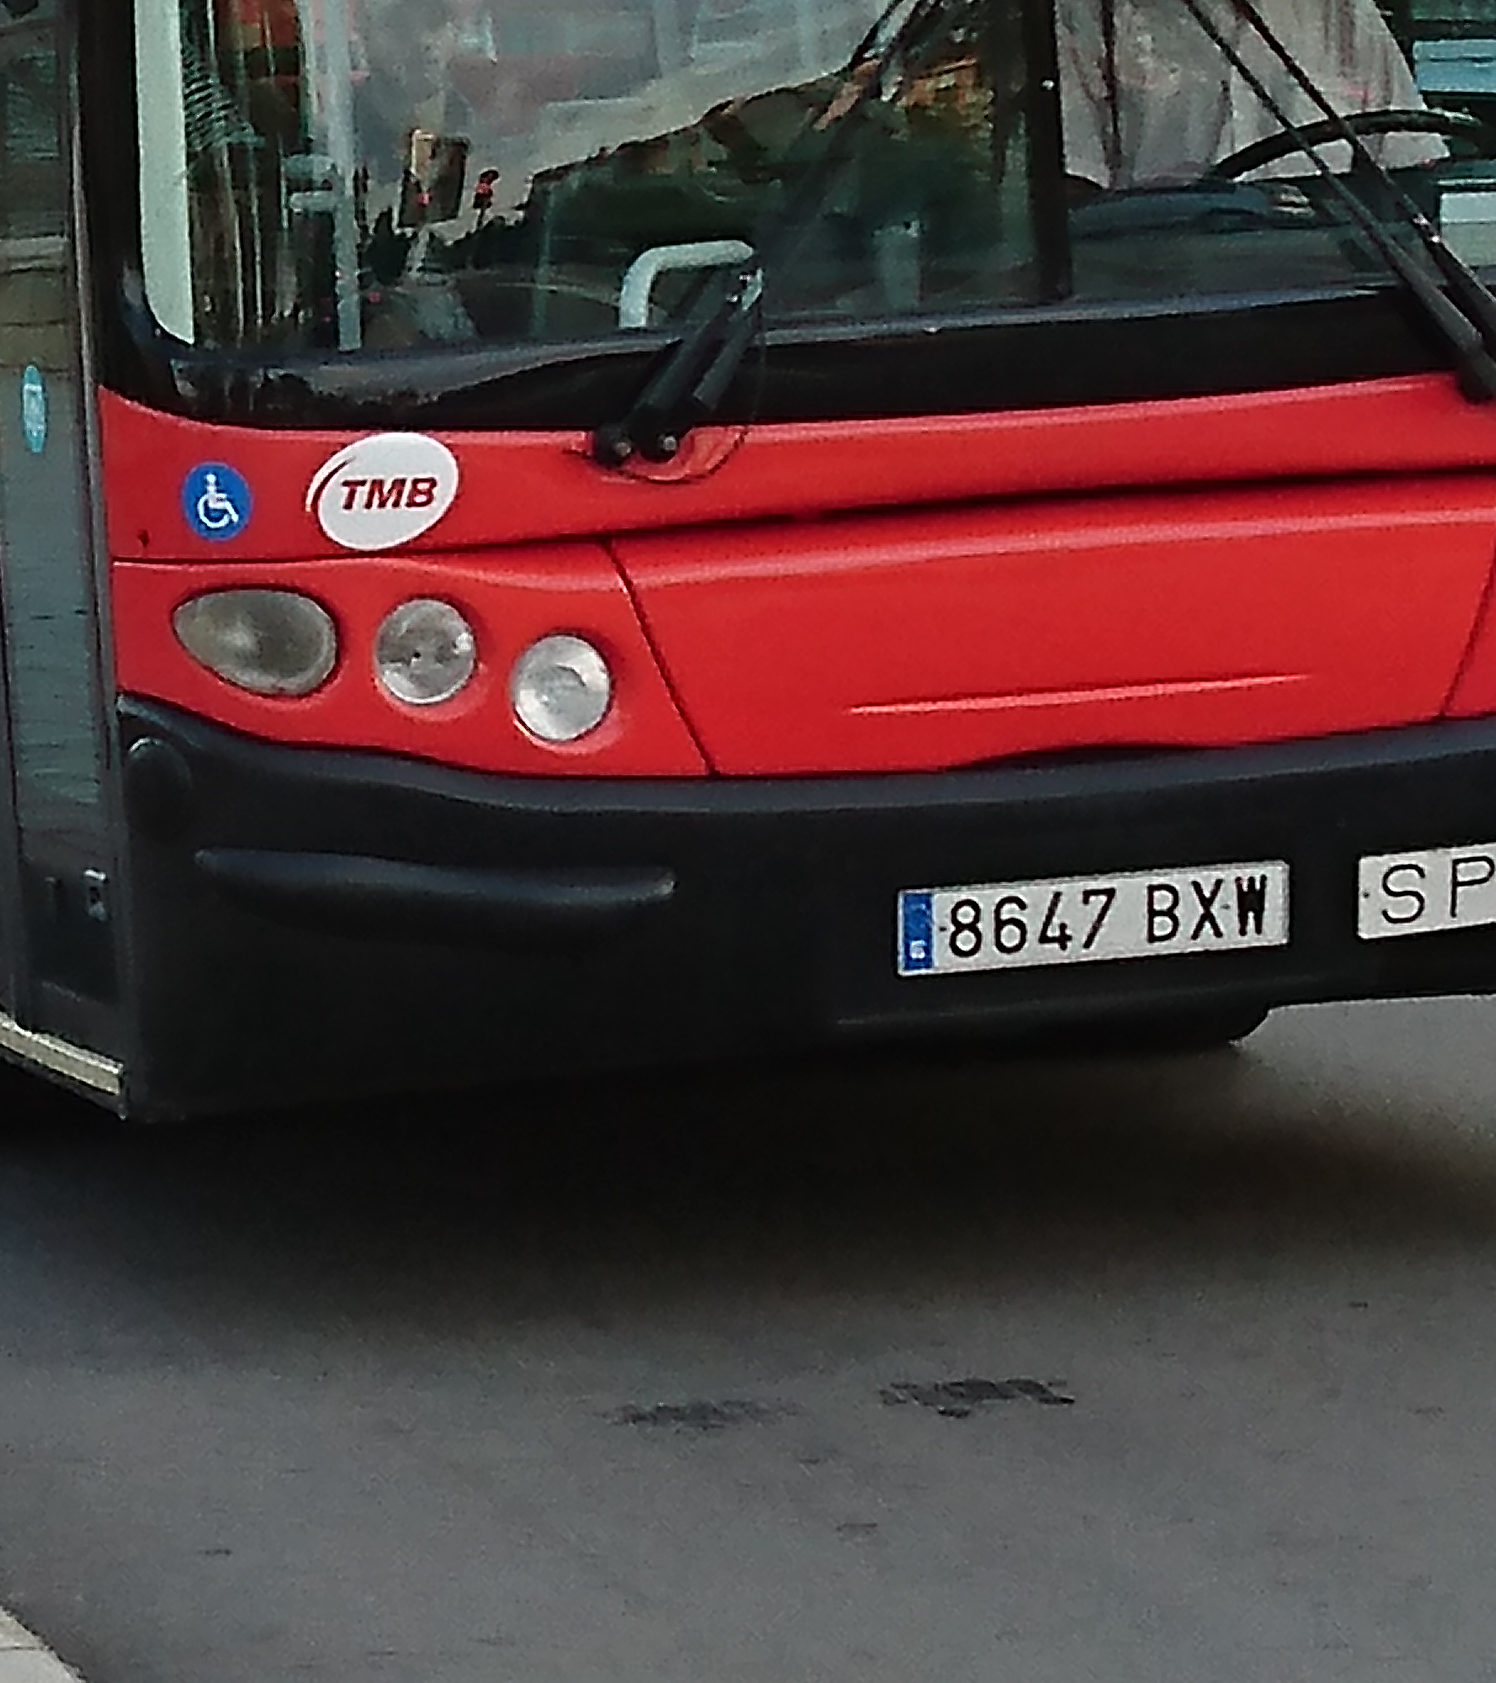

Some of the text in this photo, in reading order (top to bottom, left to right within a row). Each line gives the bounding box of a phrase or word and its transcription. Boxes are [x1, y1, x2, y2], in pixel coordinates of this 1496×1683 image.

[340, 476, 438, 512] TMB
[948, 874, 1268, 958] 8647 BXW
